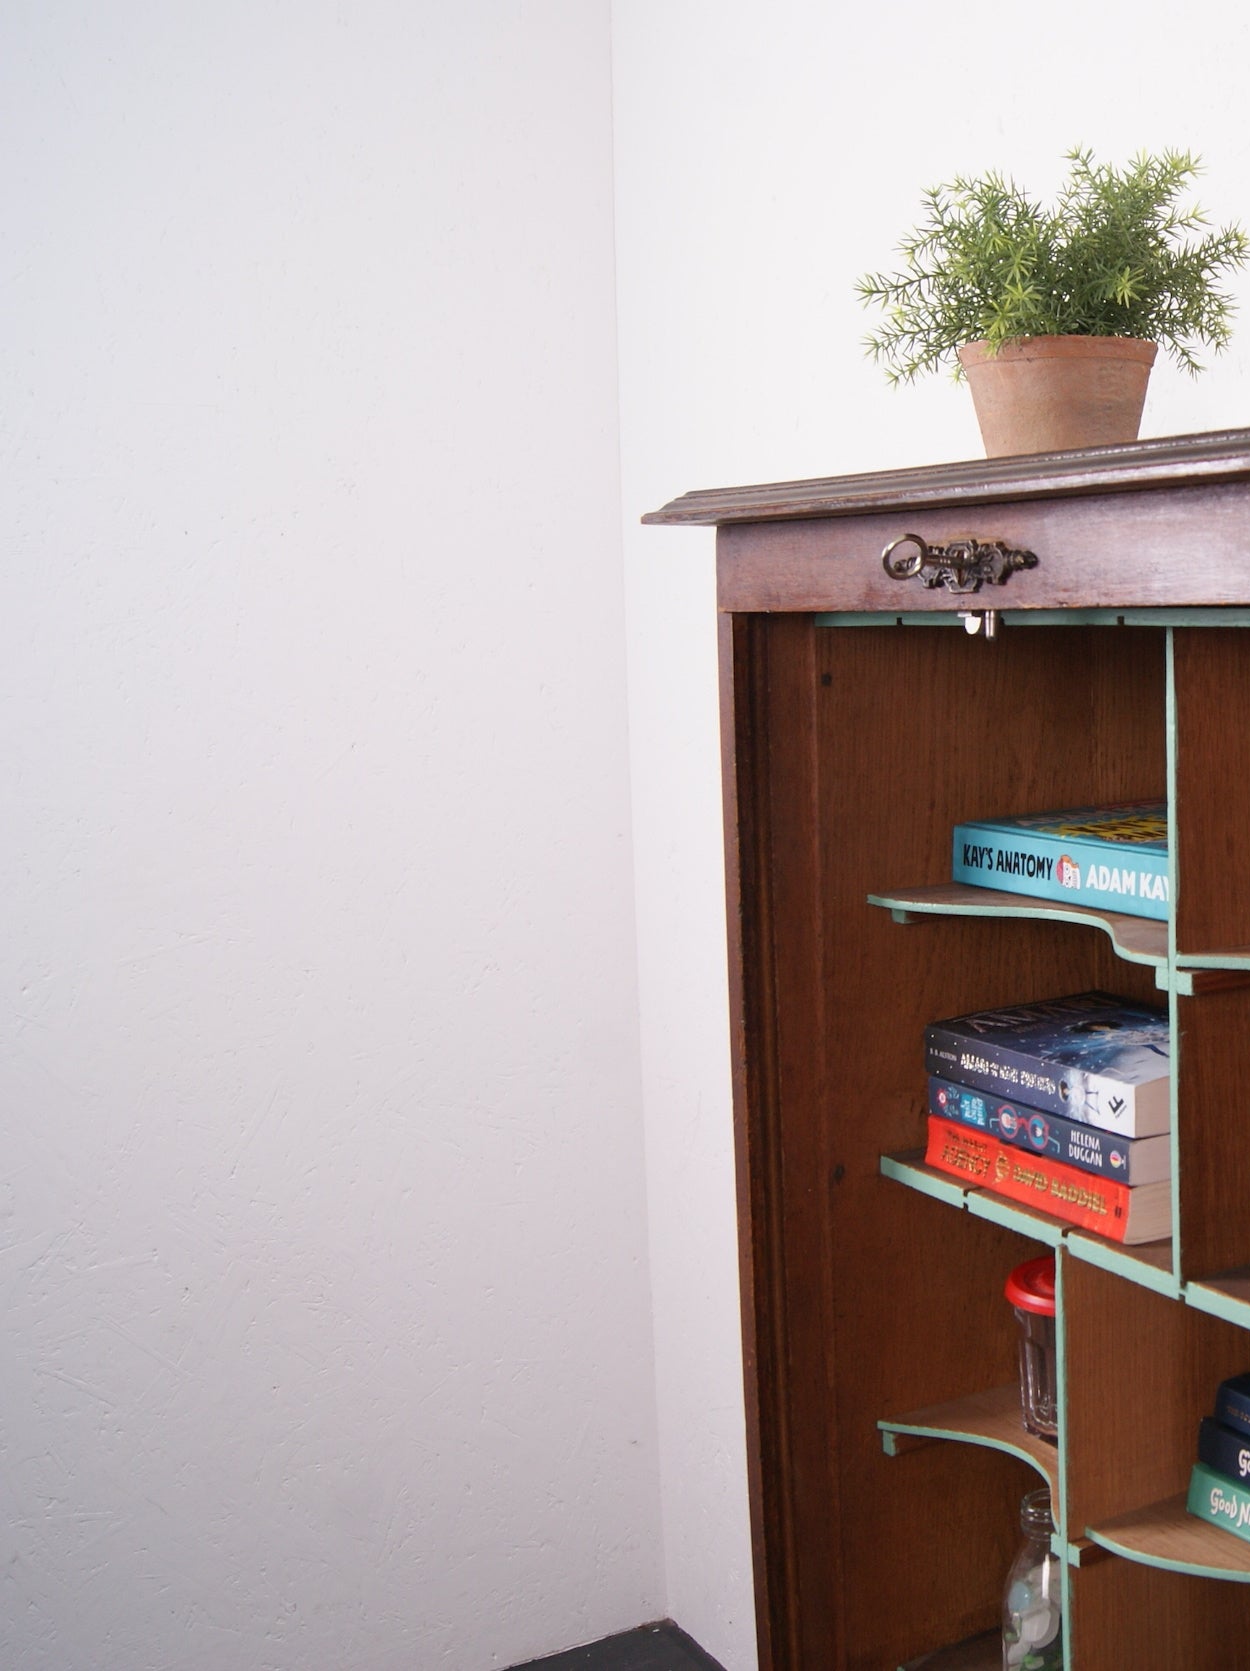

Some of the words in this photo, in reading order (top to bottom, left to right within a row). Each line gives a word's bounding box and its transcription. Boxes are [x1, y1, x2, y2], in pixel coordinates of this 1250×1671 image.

[963, 843, 993, 870] KAY'S
[996, 849, 1053, 880] ANATOMY
[1085, 863, 1136, 896] ADAM
[1068, 1143, 1103, 1167] DUGGAN
[1070, 1129, 1101, 1151] HELENA
[1013, 1164, 1048, 1192] DAVID
[1051, 1178, 1107, 1215] BADDIEL
